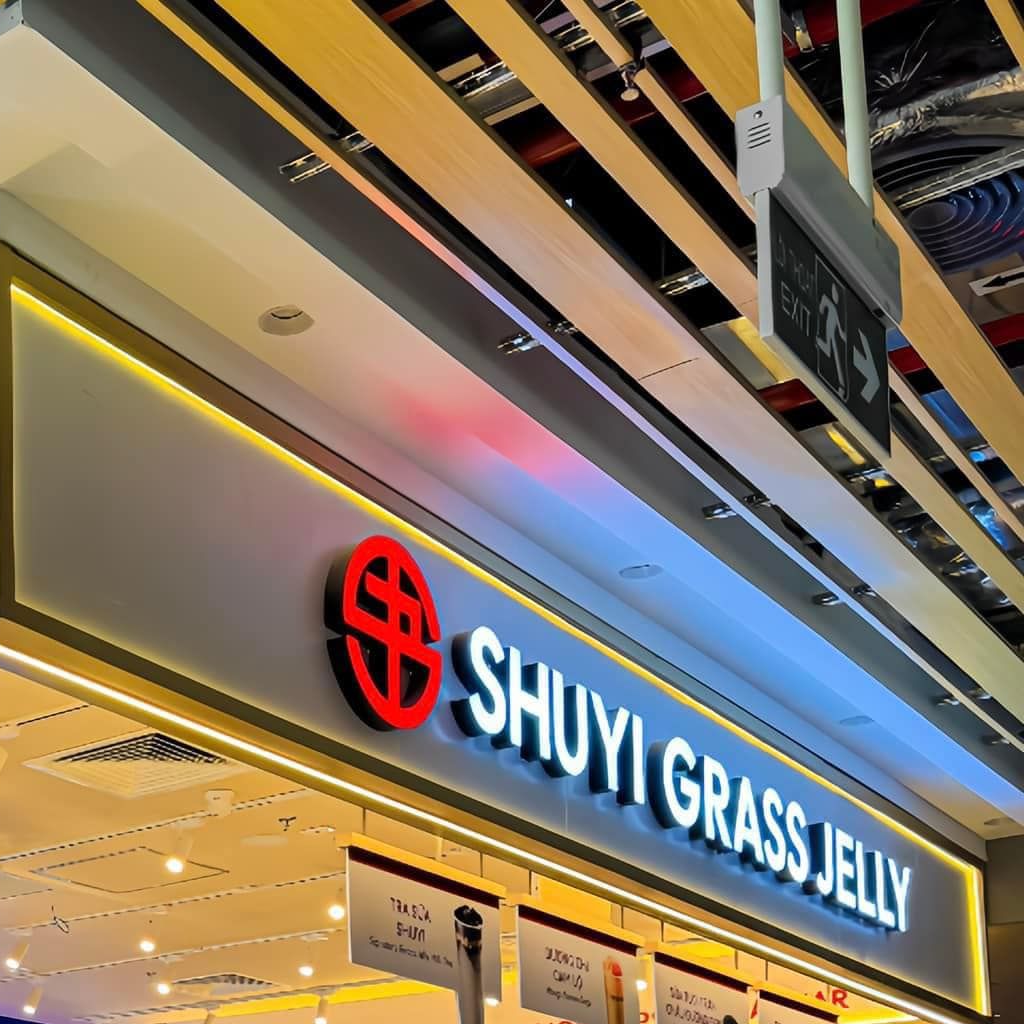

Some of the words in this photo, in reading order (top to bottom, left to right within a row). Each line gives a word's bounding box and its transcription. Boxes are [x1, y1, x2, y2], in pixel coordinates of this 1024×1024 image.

[780, 280, 811, 337] EXIT
[460, 626, 645, 805] SHUYI
[657, 737, 811, 883] GRASS
[813, 821, 912, 932] JELLY
